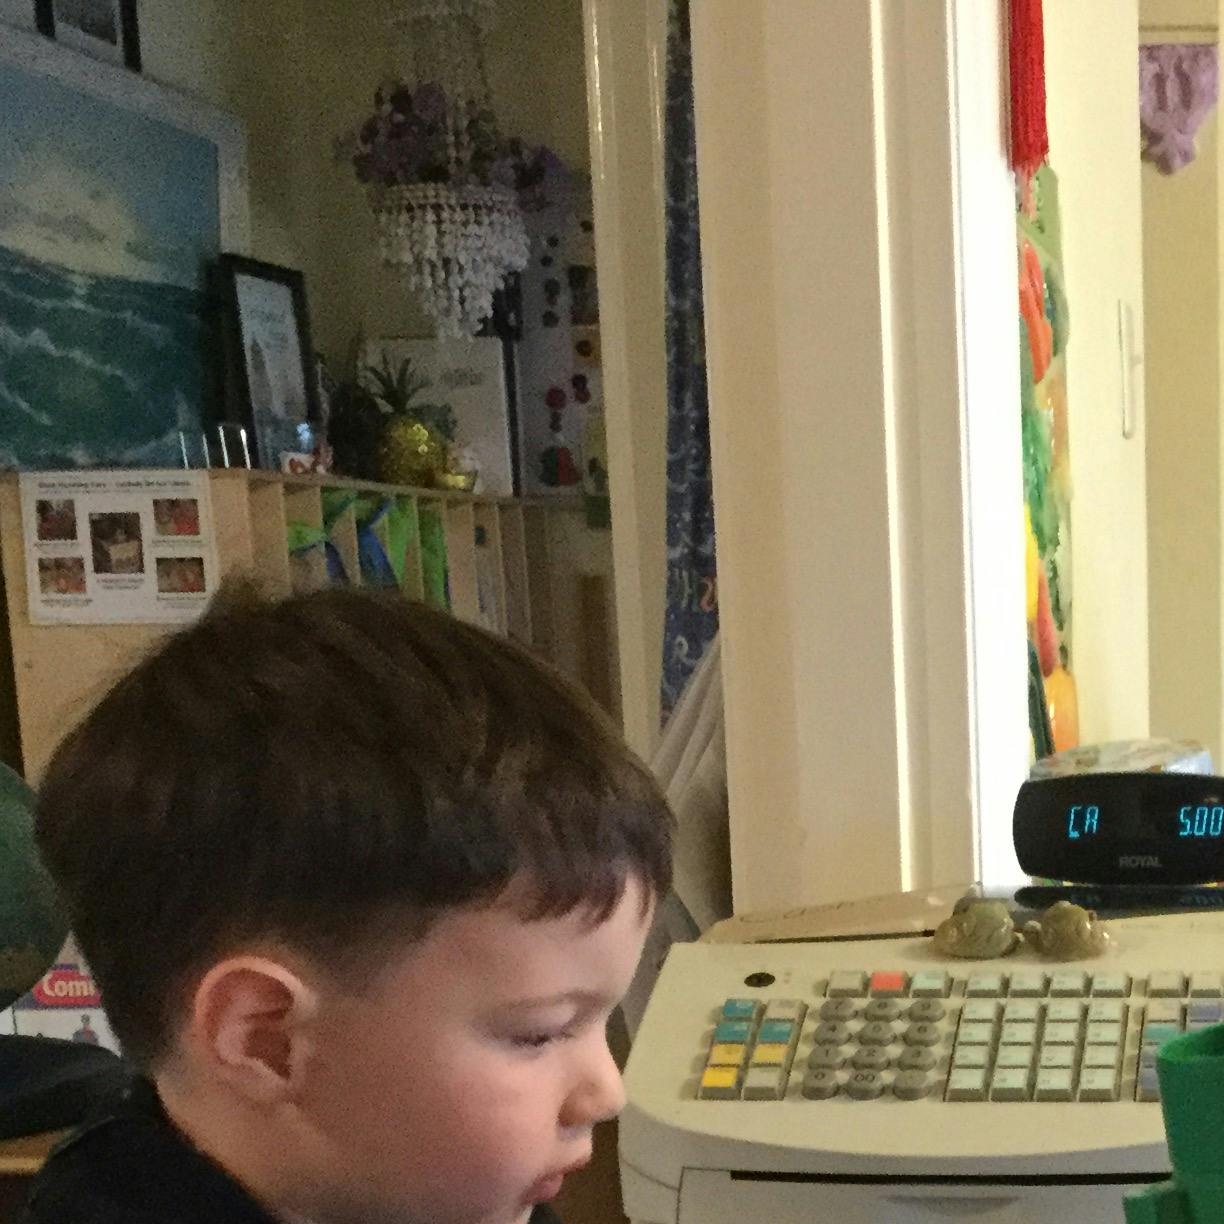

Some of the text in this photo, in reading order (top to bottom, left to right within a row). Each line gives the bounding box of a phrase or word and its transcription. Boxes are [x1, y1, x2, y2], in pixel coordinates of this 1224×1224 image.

[1068, 805, 1224, 837] CA 5.00
[1118, 854, 1163, 869] ROYAL
